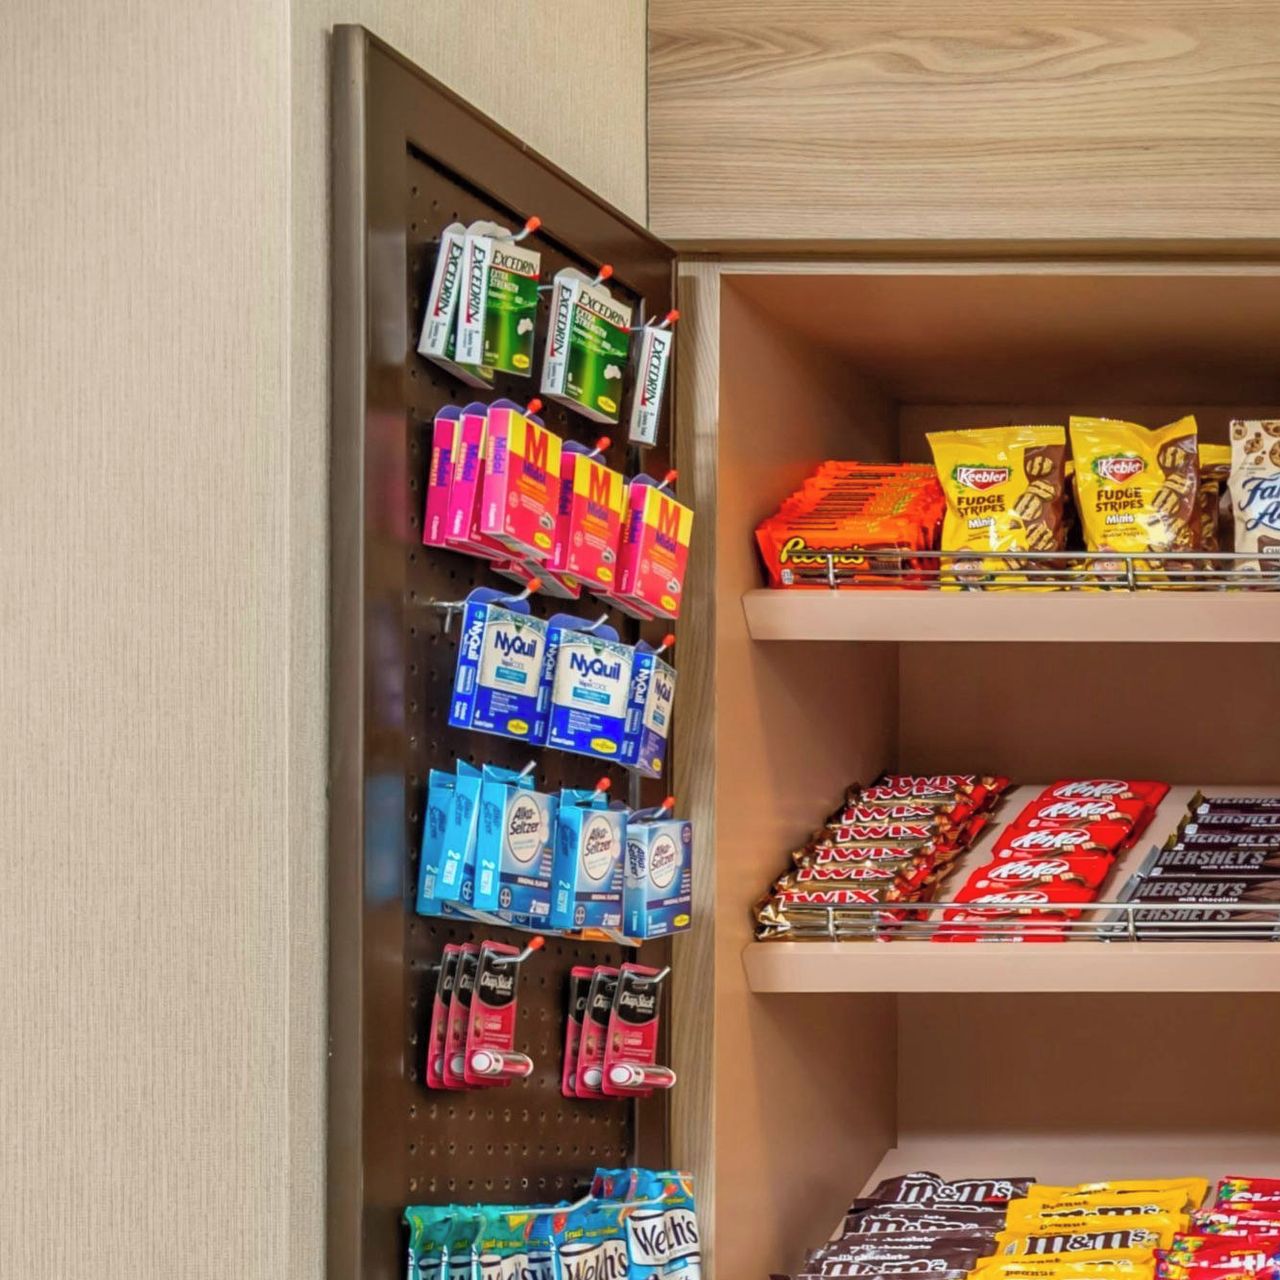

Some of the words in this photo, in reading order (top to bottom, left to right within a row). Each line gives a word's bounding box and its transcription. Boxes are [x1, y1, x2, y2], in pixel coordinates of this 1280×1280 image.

[492, 250, 537, 275] EXCEDRIN
[466, 244, 486, 324] EXCEDRIN
[578, 289, 629, 328] EXCEDRIN
[550, 283, 573, 358] EXCEDRIN
[642, 336, 666, 406] EXCEDRIN
[1100, 458, 1144, 476] Keebler
[959, 470, 1008, 485] Keebler
[957, 494, 1004, 506] FUDGE
[1097, 488, 1142, 501] FUDGE
[958, 503, 1005, 517] STRIPES
[1096, 499, 1144, 512] STRIPES
[468, 621, 483, 660] NyQuil
[495, 631, 537, 658] NyQuil
[570, 653, 620, 681] NyQuil
[510, 822, 540, 835] Seltzer
[585, 840, 611, 856] Seltzer
[1159, 850, 1265, 866] HERSHEY'S
[1138, 882, 1246, 897] HERSHEY'S
[481, 972, 513, 990] ChapStick
[620, 993, 654, 1009] ChapStick
